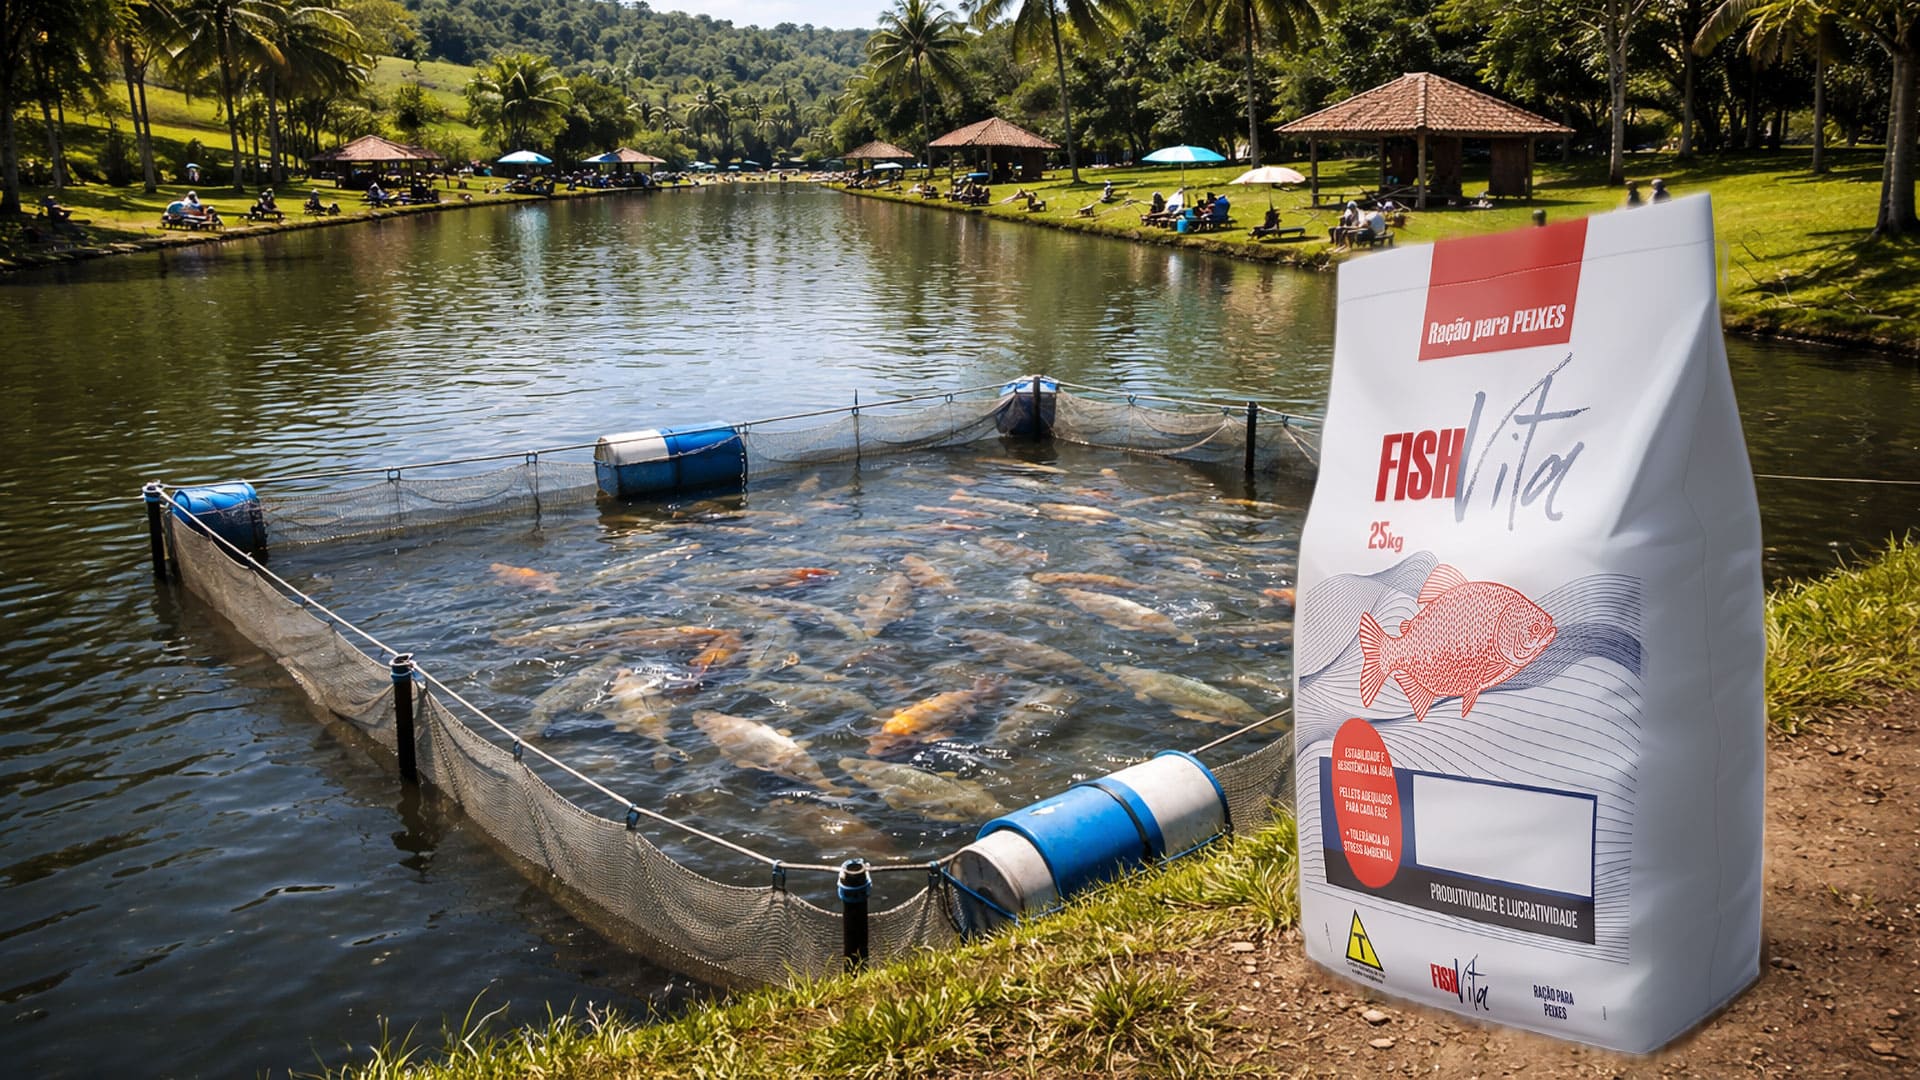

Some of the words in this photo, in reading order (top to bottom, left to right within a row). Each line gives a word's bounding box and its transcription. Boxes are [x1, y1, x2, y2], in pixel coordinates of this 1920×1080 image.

[1428, 316, 1471, 345] Ração
[1472, 315, 1510, 342] para
[1511, 303, 1567, 333] PEIXES
[1375, 428, 1466, 502] FISH
[1453, 352, 1590, 531] Vita
[1368, 521, 1404, 552] 25kg
[1345, 747, 1380, 762] ESTABILIDADE
[1381, 751, 1385, 763] E
[1337, 759, 1370, 775] RESISTÊNCIA
[1370, 764, 1378, 775] NA
[1379, 763, 1393, 778] ÁGUA
[1339, 786, 1361, 800] PELLETS
[1361, 790, 1393, 805] ADEQUADOS
[1345, 800, 1360, 814] PARA
[1360, 803, 1375, 816] CADA
[1375, 805, 1388, 819] FASE
[1350, 828, 1381, 846] TOLERÂNCIA
[1382, 835, 1390, 846] AO
[1344, 840, 1363, 855] STRESS
[1364, 845, 1393, 862] AMBIENTAL
[1430, 882, 1498, 913] PRODUTIVIDADE
[1499, 897, 1506, 915] E
[1506, 898, 1578, 929] LUCRATIVIDADE
[1430, 962, 1459, 994] FISH
[1454, 953, 1489, 1011] Vita
[1533, 984, 1556, 1002] RAÇÃO
[1556, 989, 1574, 1005] PARA
[1544, 1003, 1567, 1020] PEIXES
